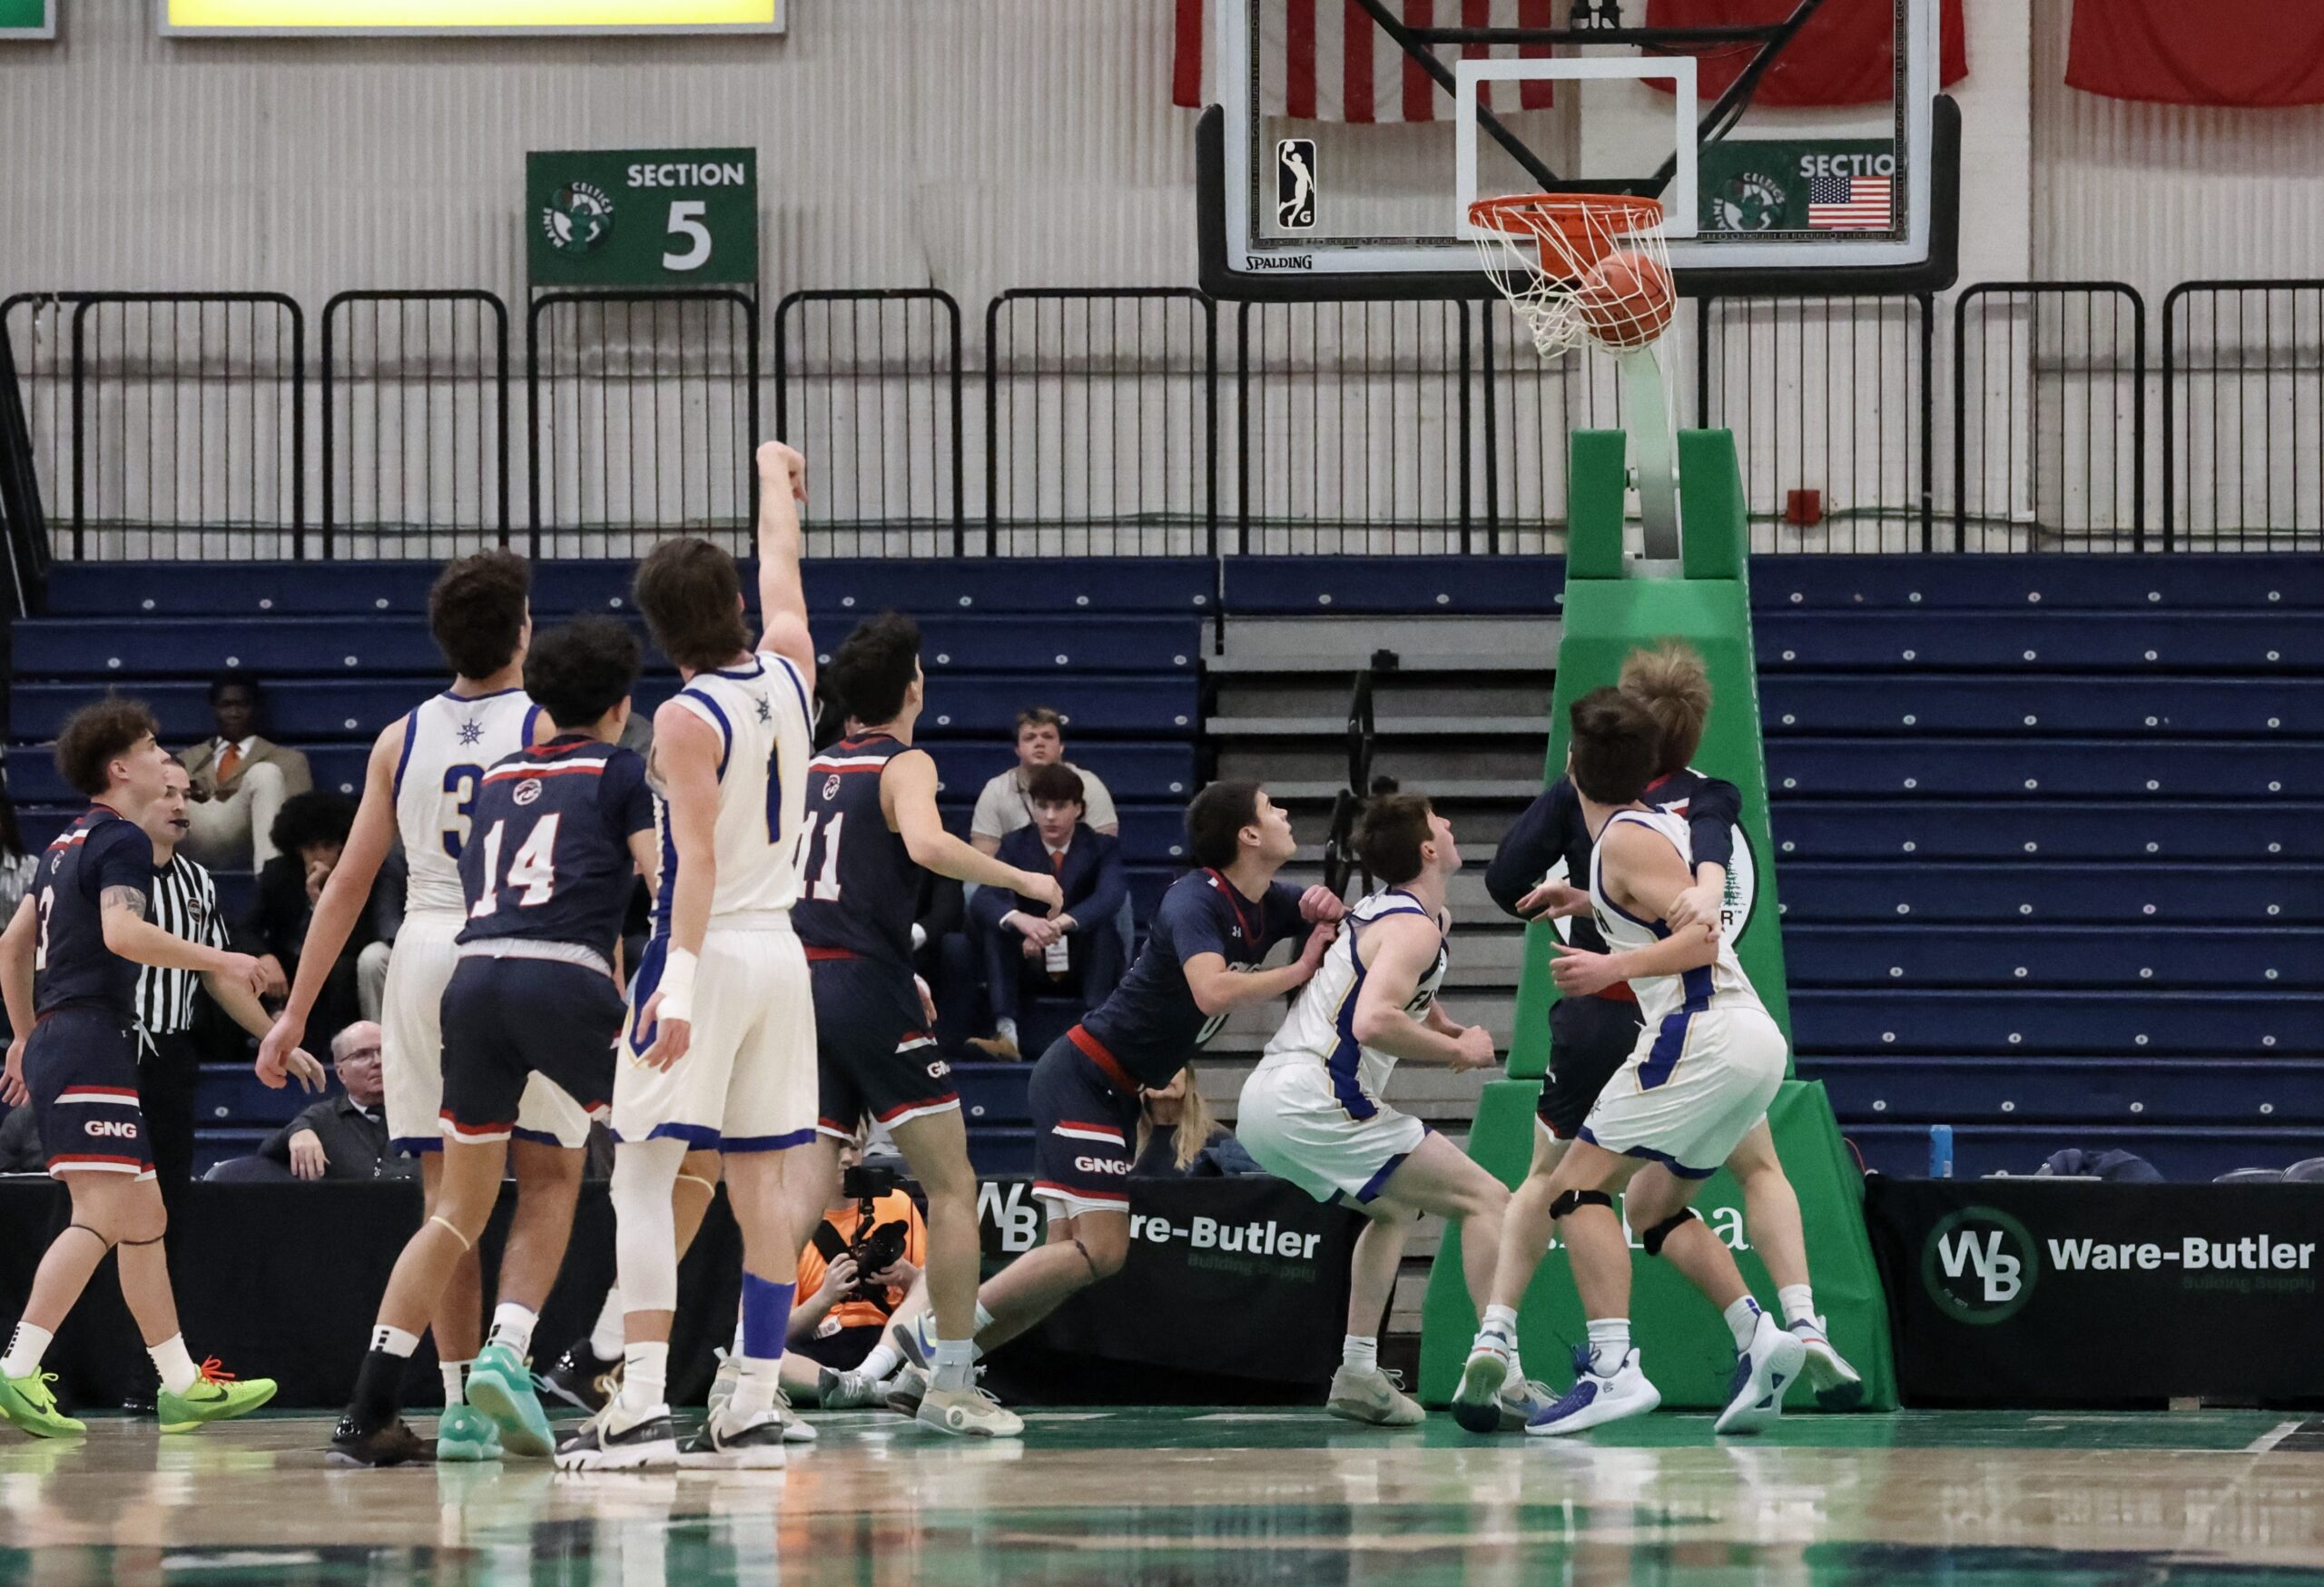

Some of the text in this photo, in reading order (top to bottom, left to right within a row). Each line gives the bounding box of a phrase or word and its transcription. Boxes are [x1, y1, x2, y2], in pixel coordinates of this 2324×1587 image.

[627, 163, 744, 187] SECTION
[1800, 154, 1896, 178] SECTIO
[572, 182, 614, 213] CELTICS
[1743, 172, 1786, 204] CELTICS
[543, 207, 565, 248] MAINE
[1300, 211, 1311, 222] G
[663, 201, 712, 271] 5
[1246, 255, 1313, 271] SPALDING
[441, 763, 486, 860] 3
[470, 813, 561, 918] 14
[795, 811, 844, 902] 11
[84, 1120, 137, 1138] GNG
[1075, 1156, 1128, 1175] GNG
[1129, 1213, 1321, 1259] re-Butler
[2047, 1234, 2316, 1270] Ware-Butler
[1937, 1230, 2022, 1301] WB
